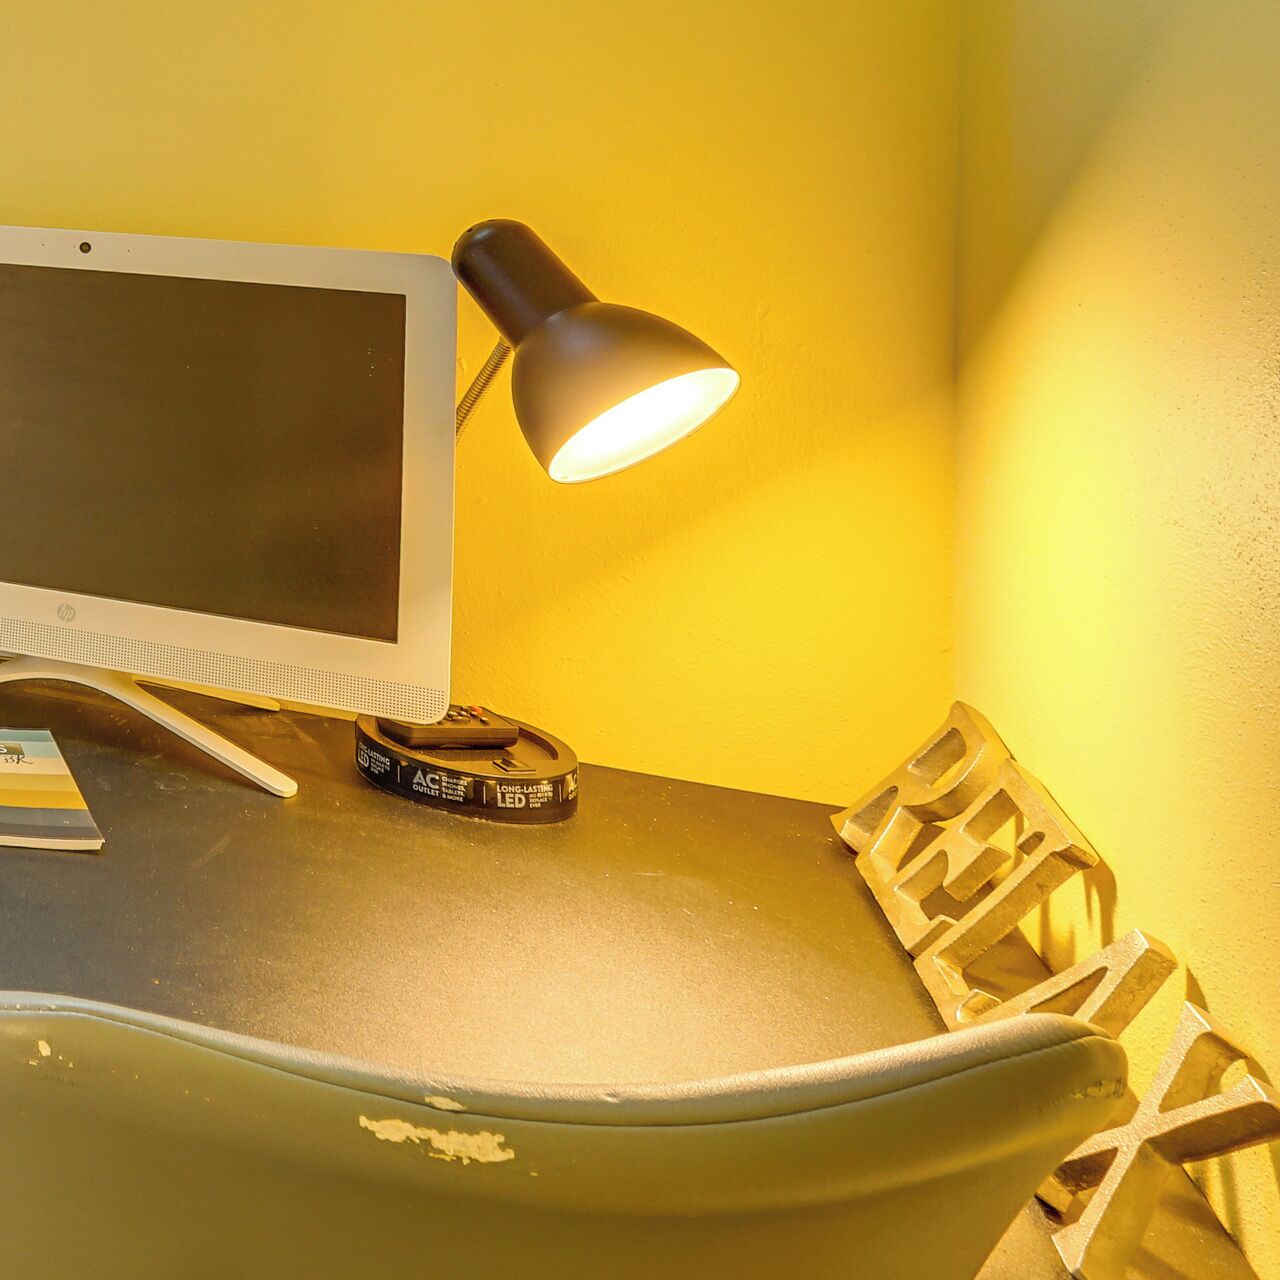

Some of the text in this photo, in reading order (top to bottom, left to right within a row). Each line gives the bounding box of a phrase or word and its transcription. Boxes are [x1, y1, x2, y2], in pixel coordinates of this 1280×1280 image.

[413, 770, 439, 789] AC
[412, 784, 440, 797] OUTLET
[496, 783, 553, 793] LONG-LASTING
[497, 793, 526, 808] LED
